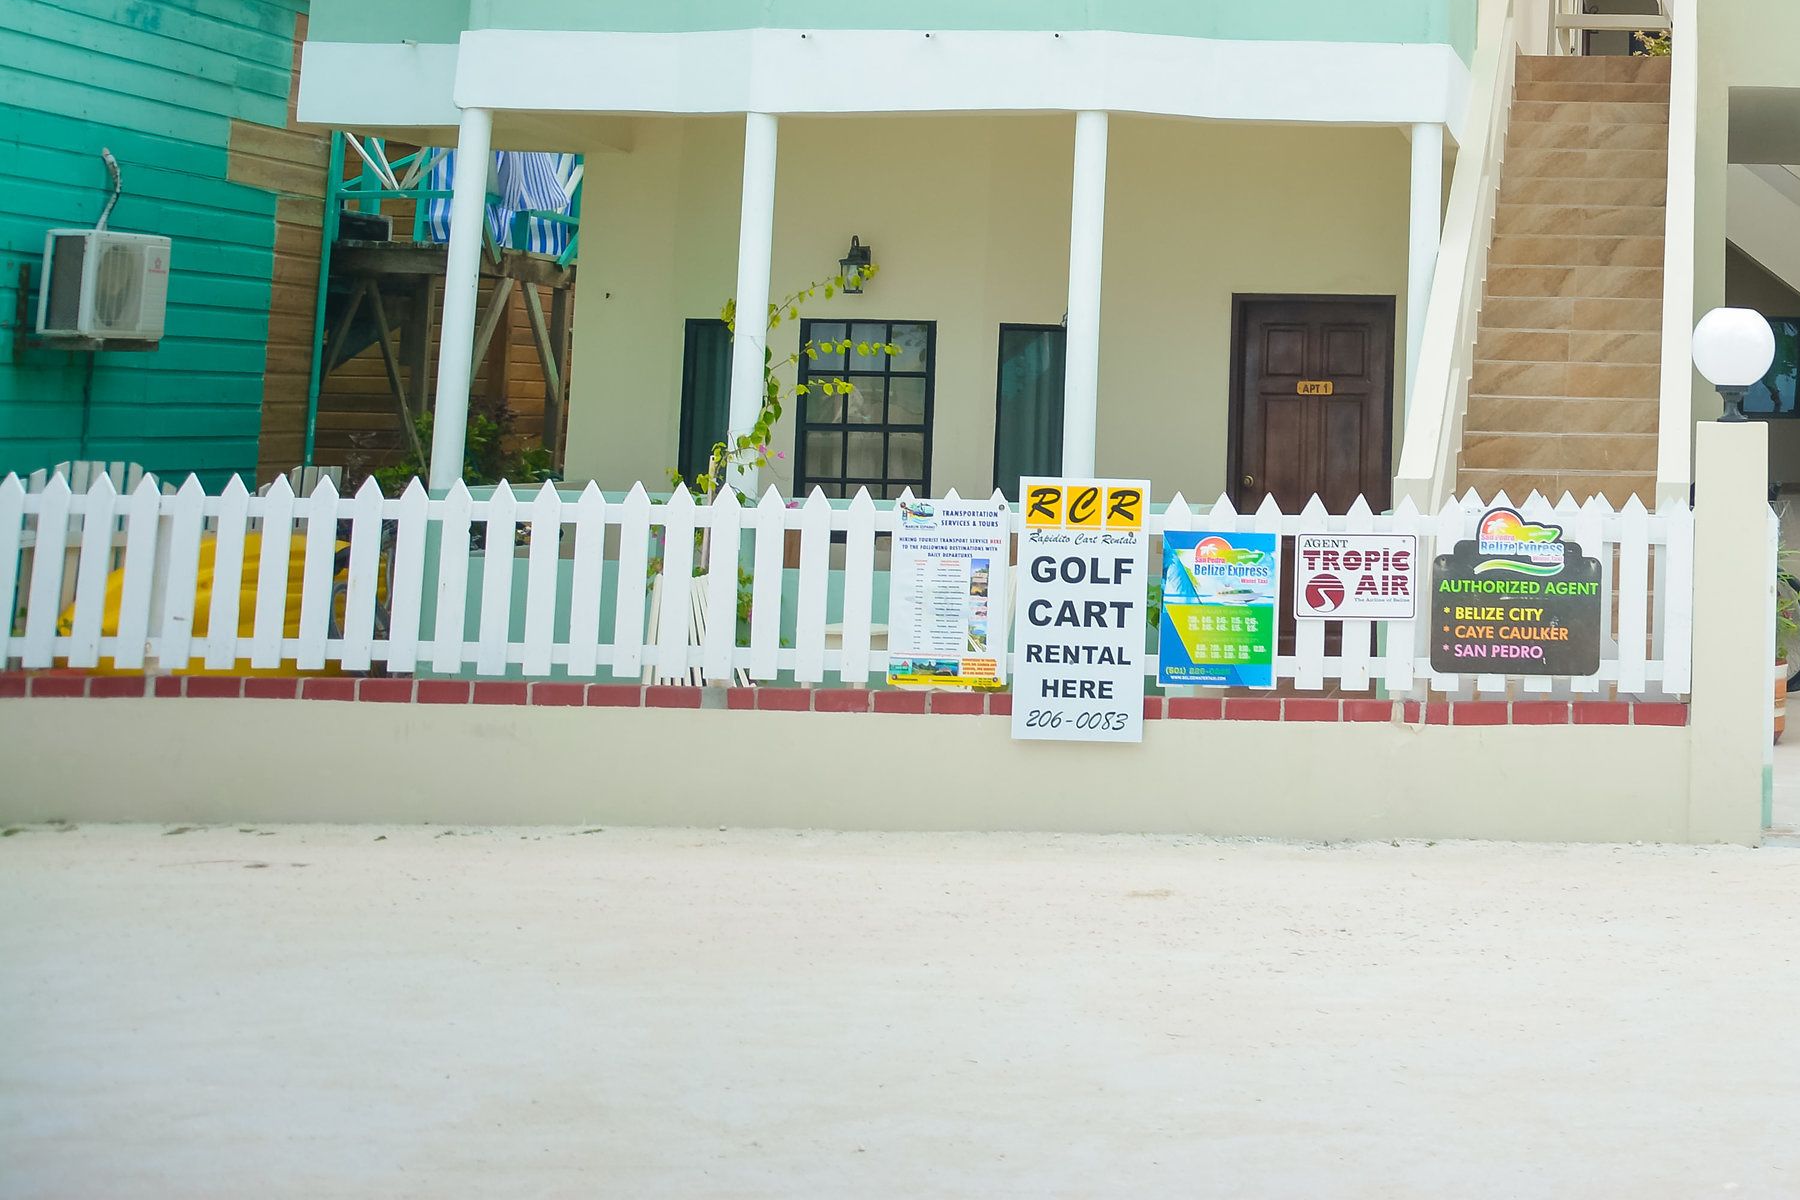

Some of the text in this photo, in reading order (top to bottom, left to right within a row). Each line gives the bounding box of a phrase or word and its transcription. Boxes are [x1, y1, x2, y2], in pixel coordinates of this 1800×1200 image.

[1303, 384, 1328, 393] APT 1
[1028, 487, 1140, 523] RCR
[942, 510, 998, 518] TRANSPORTATION
[1029, 532, 1137, 545] Rapidito Cart Rentals
[1304, 539, 1348, 548] AGENT
[1481, 541, 1515, 553] Belize
[1303, 548, 1411, 571] TROPIC
[1031, 556, 1134, 584] GOLF
[1194, 564, 1268, 577] Belize Express
[1355, 575, 1409, 595] AIR
[1439, 580, 1598, 595] AUTHORIZED AGENT
[1028, 599, 1133, 628] CART
[1455, 607, 1543, 621] BELIZE CITY
[1455, 625, 1568, 640] CAYE CAULKER
[1026, 644, 1131, 665] RENTAL
[1454, 644, 1543, 659] SAN PEDRO
[1041, 679, 1113, 699] HERE
[1026, 710, 1128, 731] 206-0083
